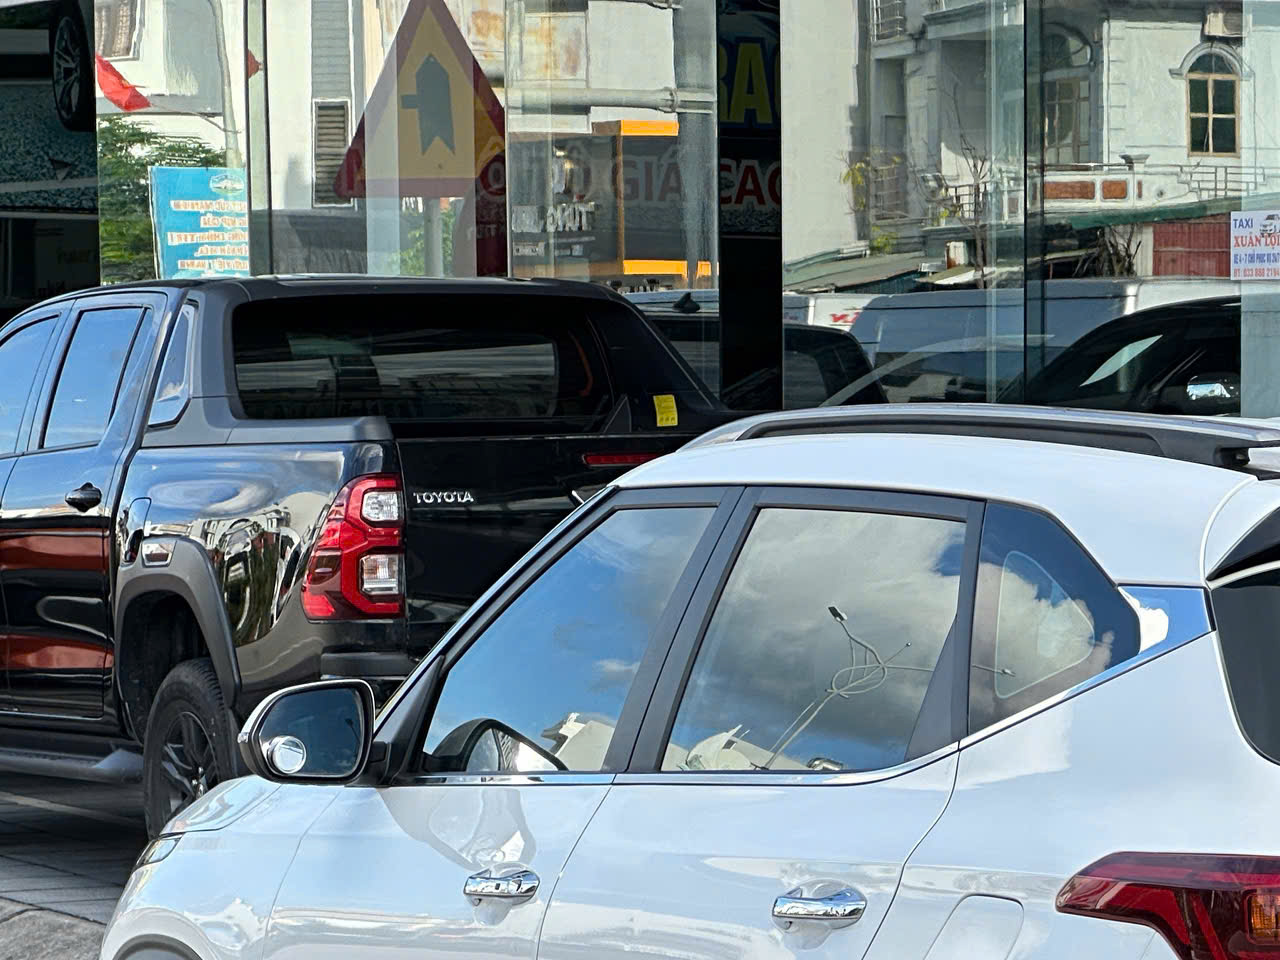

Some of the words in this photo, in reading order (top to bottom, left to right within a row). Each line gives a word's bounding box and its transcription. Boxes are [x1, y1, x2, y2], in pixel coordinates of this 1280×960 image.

[1233, 218, 1253, 229] TAXI
[1233, 232, 1261, 248] XUÂN
[413, 491, 475, 504] TOYOTA
